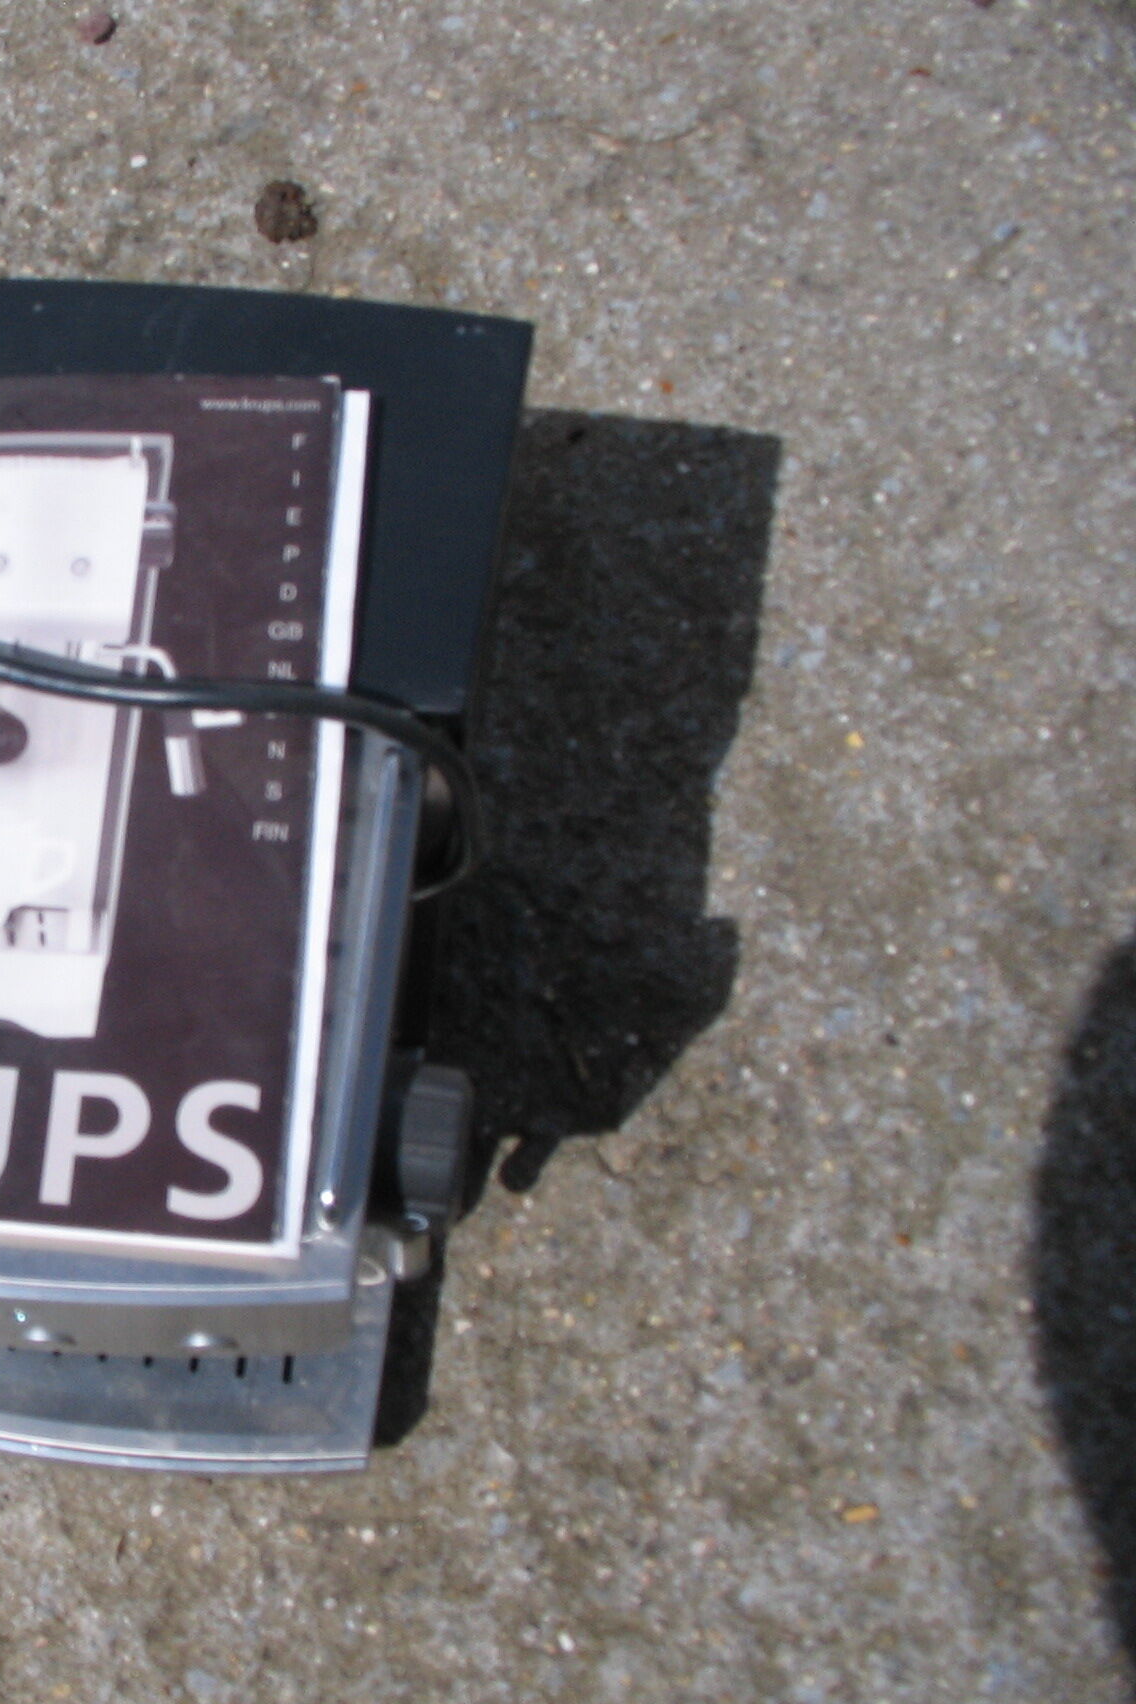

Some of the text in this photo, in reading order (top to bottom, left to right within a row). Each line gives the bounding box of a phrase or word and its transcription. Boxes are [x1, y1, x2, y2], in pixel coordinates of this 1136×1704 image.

[286, 506, 303, 526] E
[282, 544, 301, 563] P
[279, 582, 298, 602] D
[267, 620, 304, 641] GB
[268, 741, 286, 760] N
